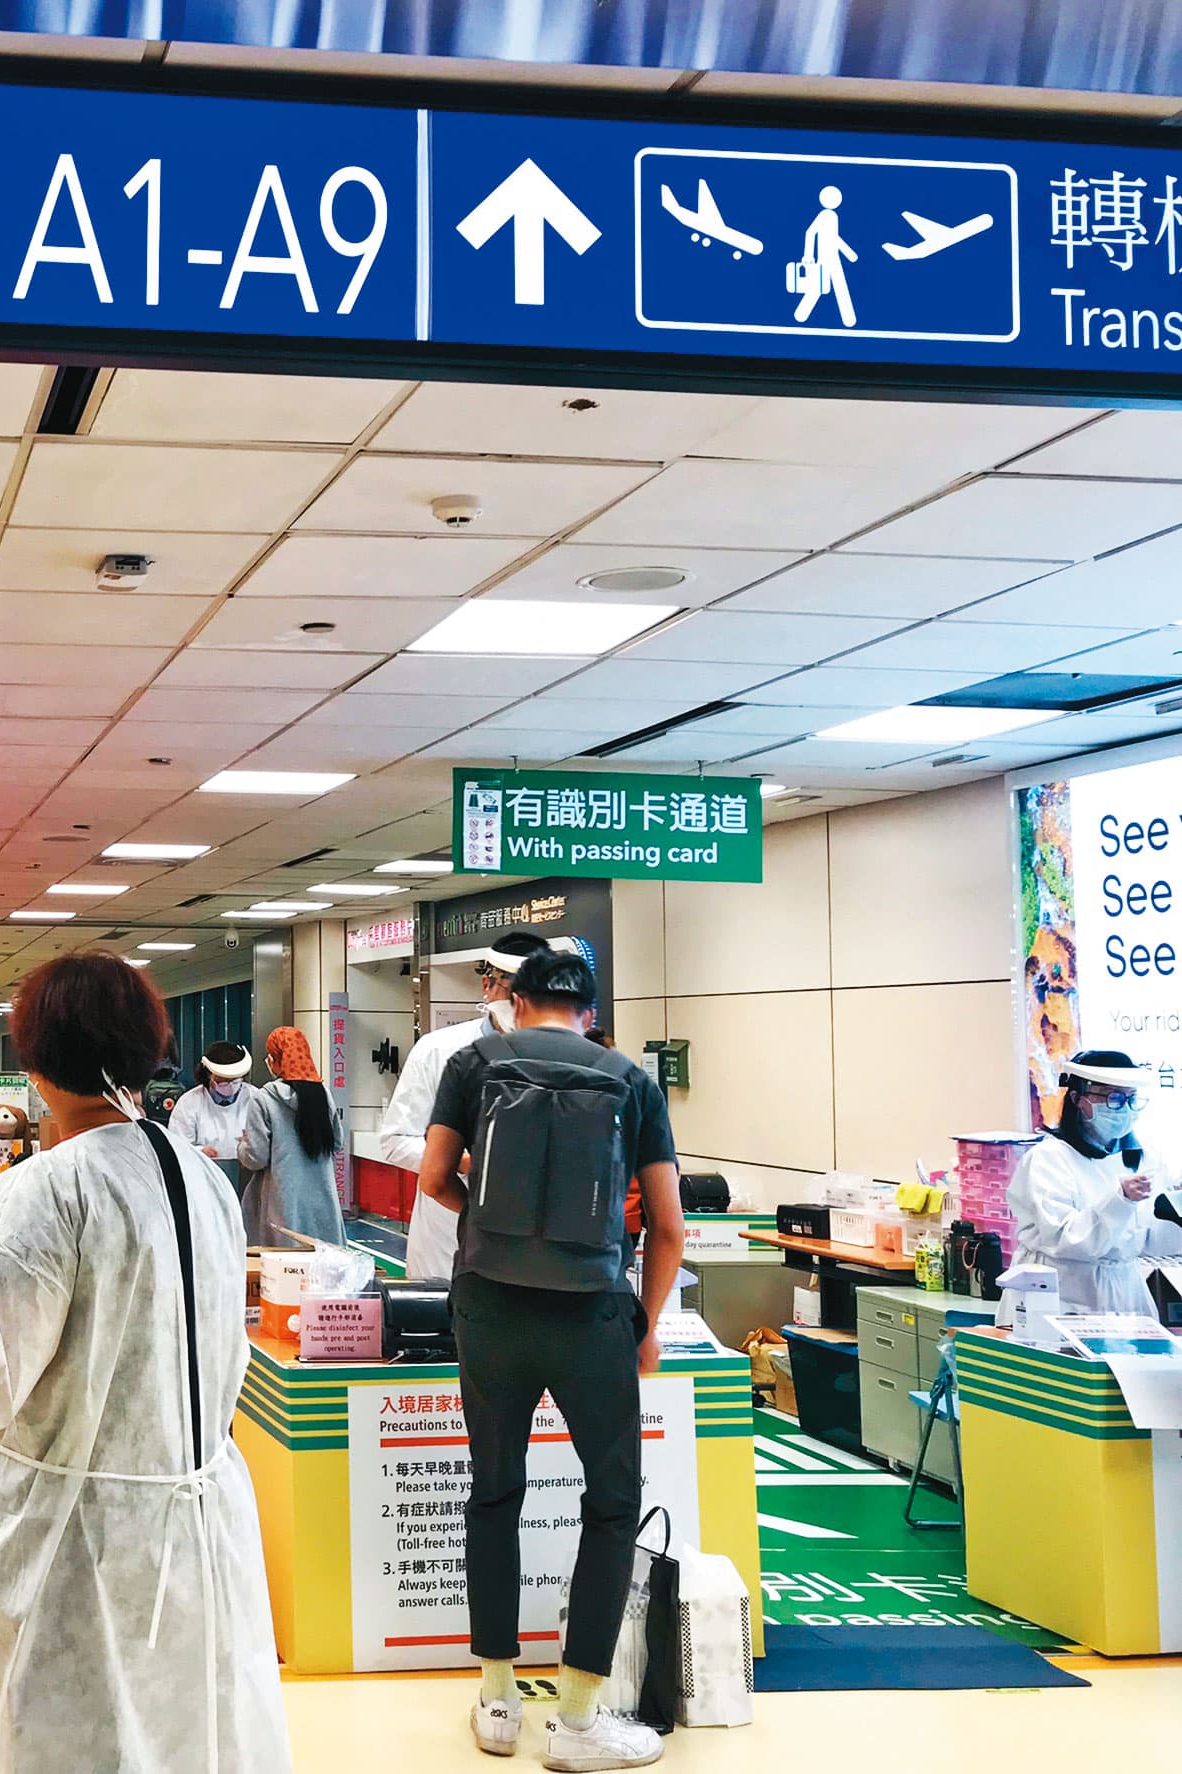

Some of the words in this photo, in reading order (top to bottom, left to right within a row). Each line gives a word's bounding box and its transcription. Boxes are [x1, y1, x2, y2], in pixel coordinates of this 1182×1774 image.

[11, 152, 389, 315] A1-A9
[1050, 288, 1182, 351] Trans
[505, 786, 749, 835] 有識別卡通道
[1100, 814, 1170, 858] See
[507, 836, 564, 859] With
[571, 840, 661, 868] passing
[668, 842, 718, 864] card
[1103, 874, 1173, 918] See
[1106, 934, 1176, 978] See
[1109, 1009, 1150, 1032] Your
[698, 1241, 732, 1249] quarantine
[380, 1419, 448, 1432] Precautions
[450, 1419, 463, 1430] to
[536, 1415, 555, 1427] the
[381, 1464, 393, 1477] 1.
[396, 1481, 431, 1493] Please
[433, 1480, 457, 1491] take
[381, 1504, 394, 1517] 2.
[397, 1521, 405, 1533] If
[407, 1523, 427, 1536] you
[397, 1537, 446, 1552] (Toll-free
[383, 1562, 395, 1575] 3.
[398, 1579, 438, 1593] Always
[440, 1577, 466, 1591] keep
[398, 1597, 438, 1608] answer
[441, 1594, 468, 1606] calls.
